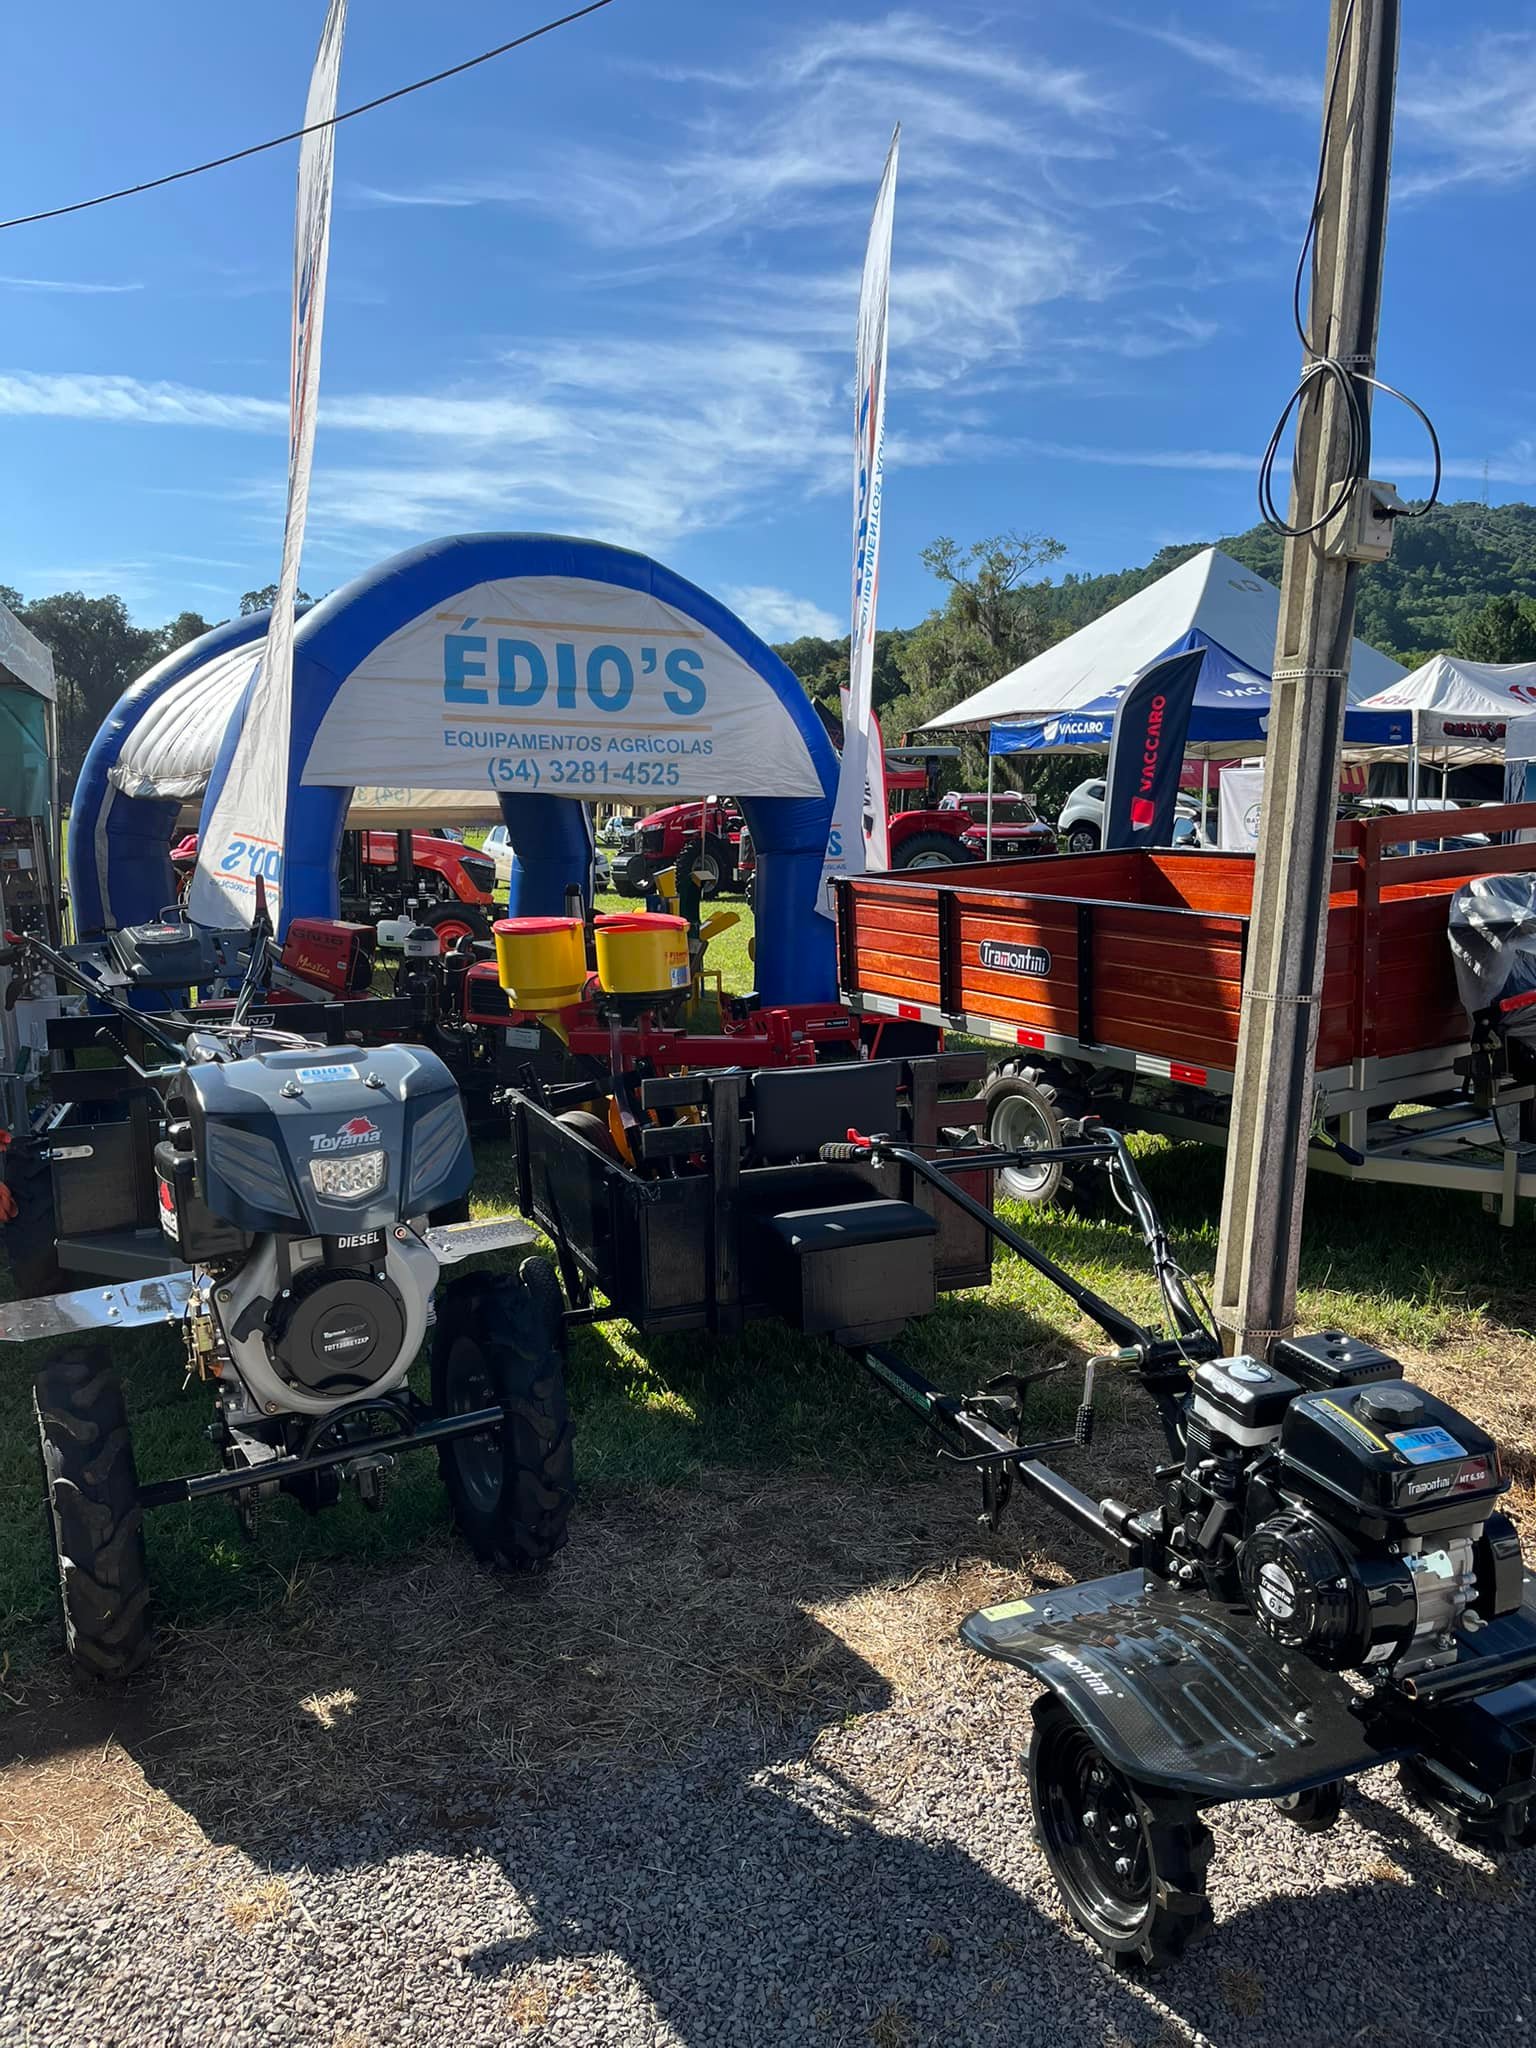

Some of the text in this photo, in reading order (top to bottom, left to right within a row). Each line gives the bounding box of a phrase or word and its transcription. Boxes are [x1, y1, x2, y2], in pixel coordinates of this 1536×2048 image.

[443, 617, 707, 716] ÉDIO'S
[1059, 721, 1103, 735] VACCARO
[444, 730, 713, 755] EQUIPAMENTOS AGRÍCOLAS
[1140, 695, 1166, 792] VACCARO
[487, 757, 680, 788] (54) 3281-4525
[983, 942, 1046, 972] Tramontini
[309, 1131, 381, 1152] Toyama
[338, 1231, 380, 1249] DIESEL
[1407, 1476, 1450, 1496] Tramontini
[1269, 1596, 1282, 1614] 6.5
[1039, 1643, 1114, 1696] Tramontini
